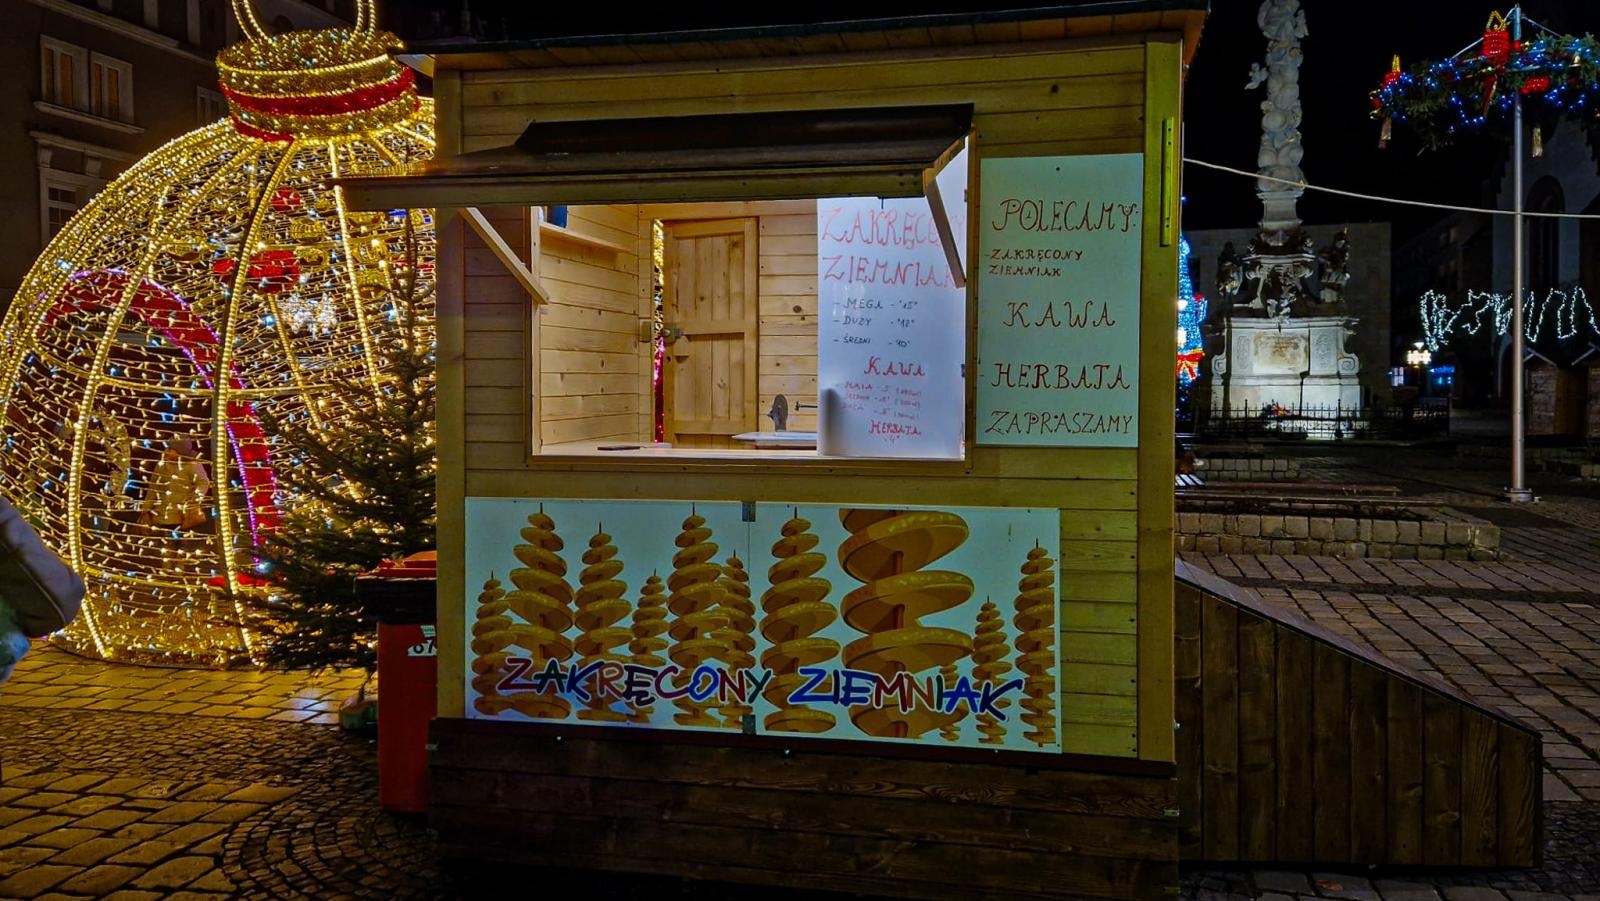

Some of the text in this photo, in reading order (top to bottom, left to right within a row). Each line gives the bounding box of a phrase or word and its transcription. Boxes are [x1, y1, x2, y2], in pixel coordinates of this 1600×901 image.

[988, 265, 1062, 277] ZIEMNIAK
[843, 299, 883, 309] MEGA
[1003, 300, 1116, 329] KAWA
[864, 355, 925, 377] KAWA
[991, 363, 1130, 390] HERBATA
[868, 419, 921, 436] HERBATA
[985, 410, 1132, 434] ZAPRASZAMY
[497, 657, 1024, 721] ZAKRĘCONY ZIEMNIAK
